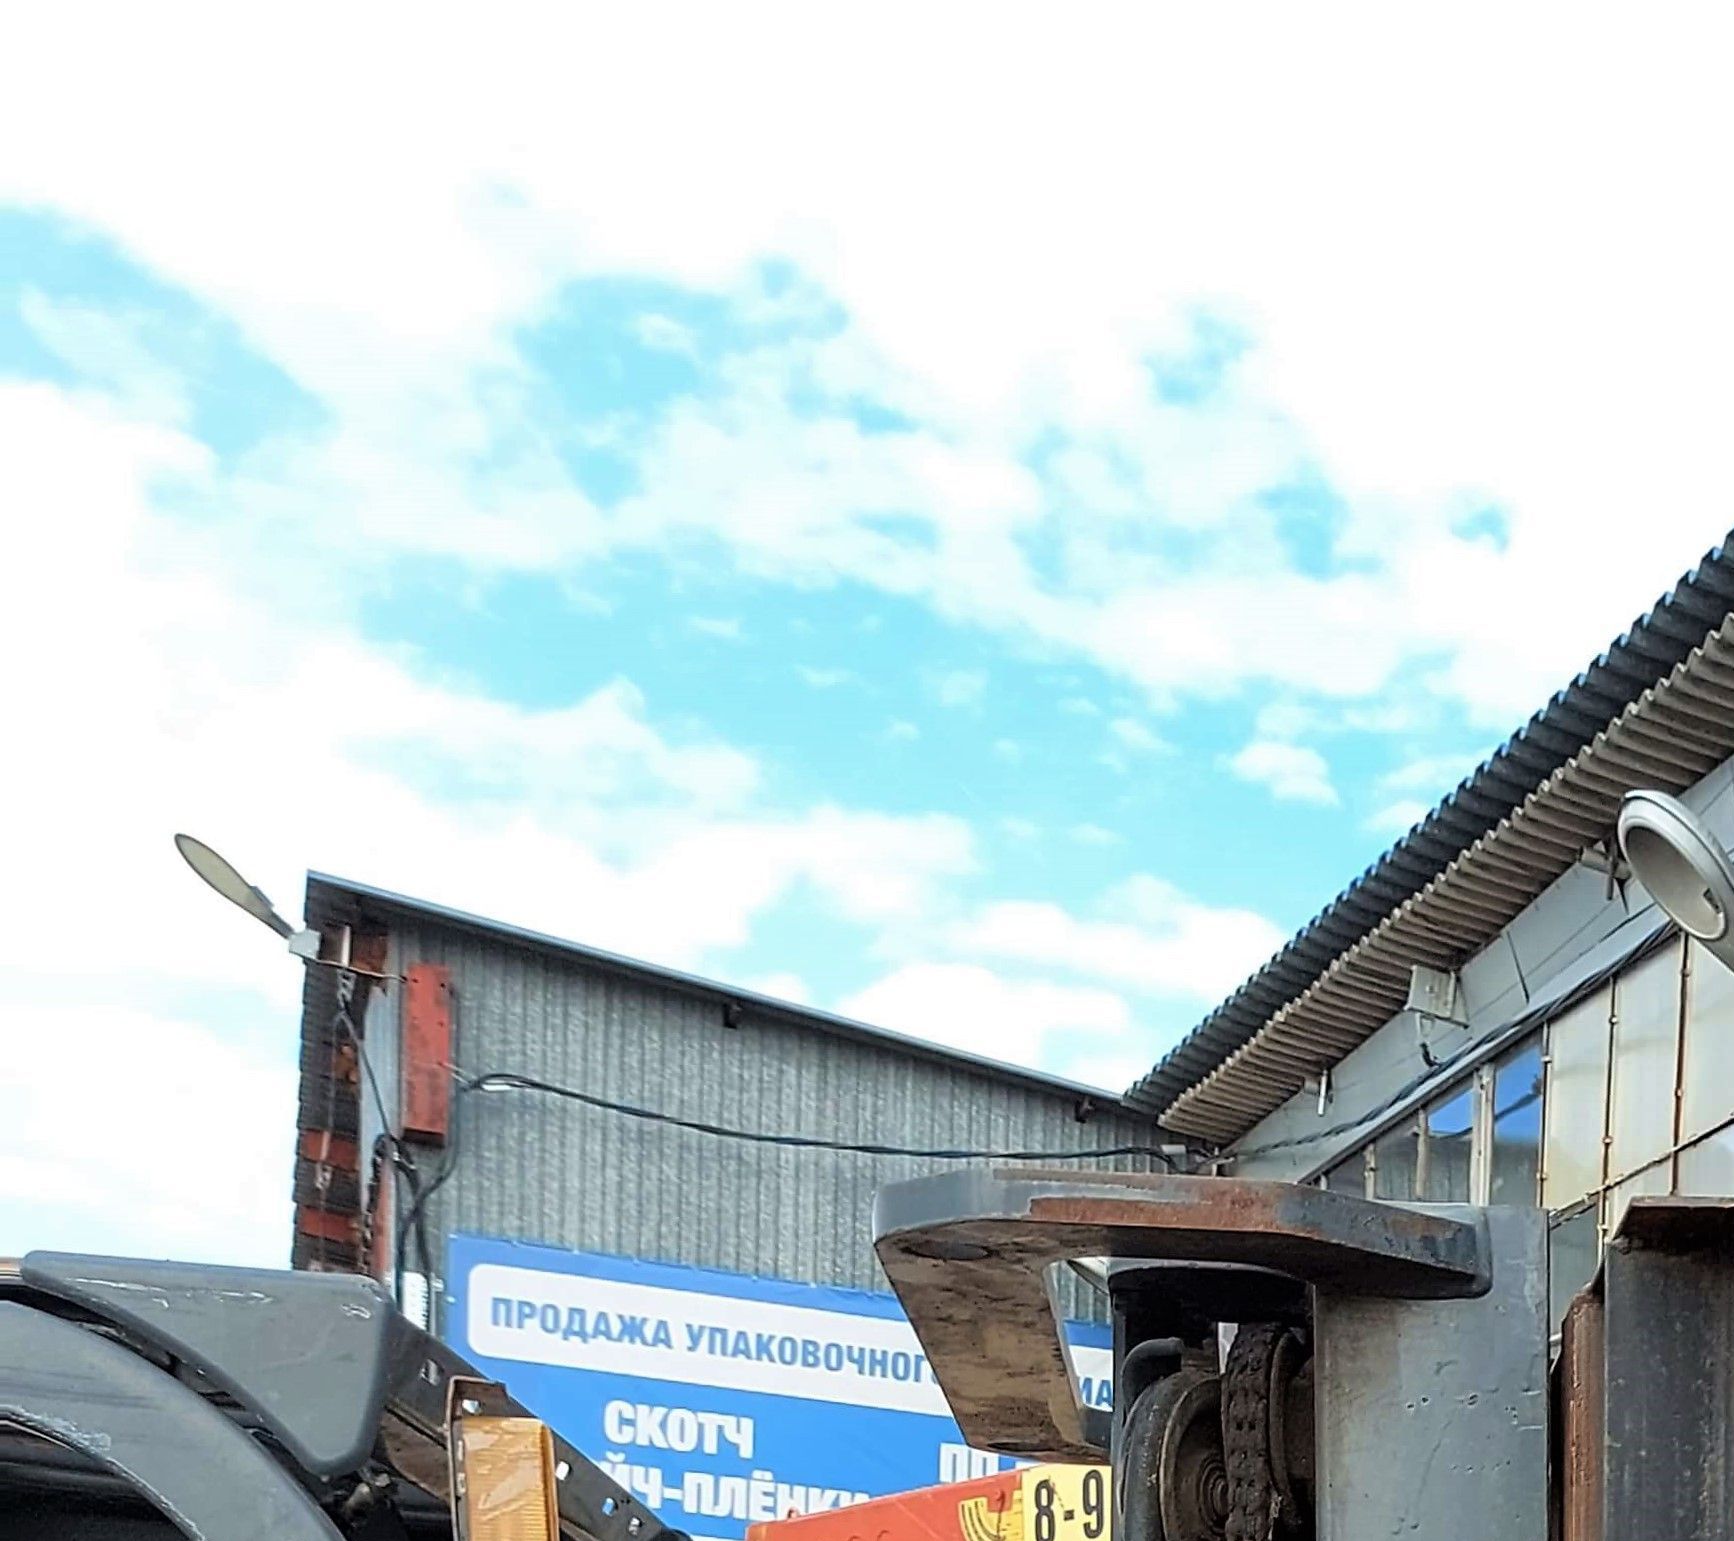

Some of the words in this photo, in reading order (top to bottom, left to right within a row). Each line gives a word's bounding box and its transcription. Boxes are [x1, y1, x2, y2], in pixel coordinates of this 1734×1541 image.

[490, 1295, 673, 1350] ПРОДАЖА
[686, 1322, 939, 1385] УПАКОВОЧНОГ
[604, 1400, 754, 1459] СКОТЧ
